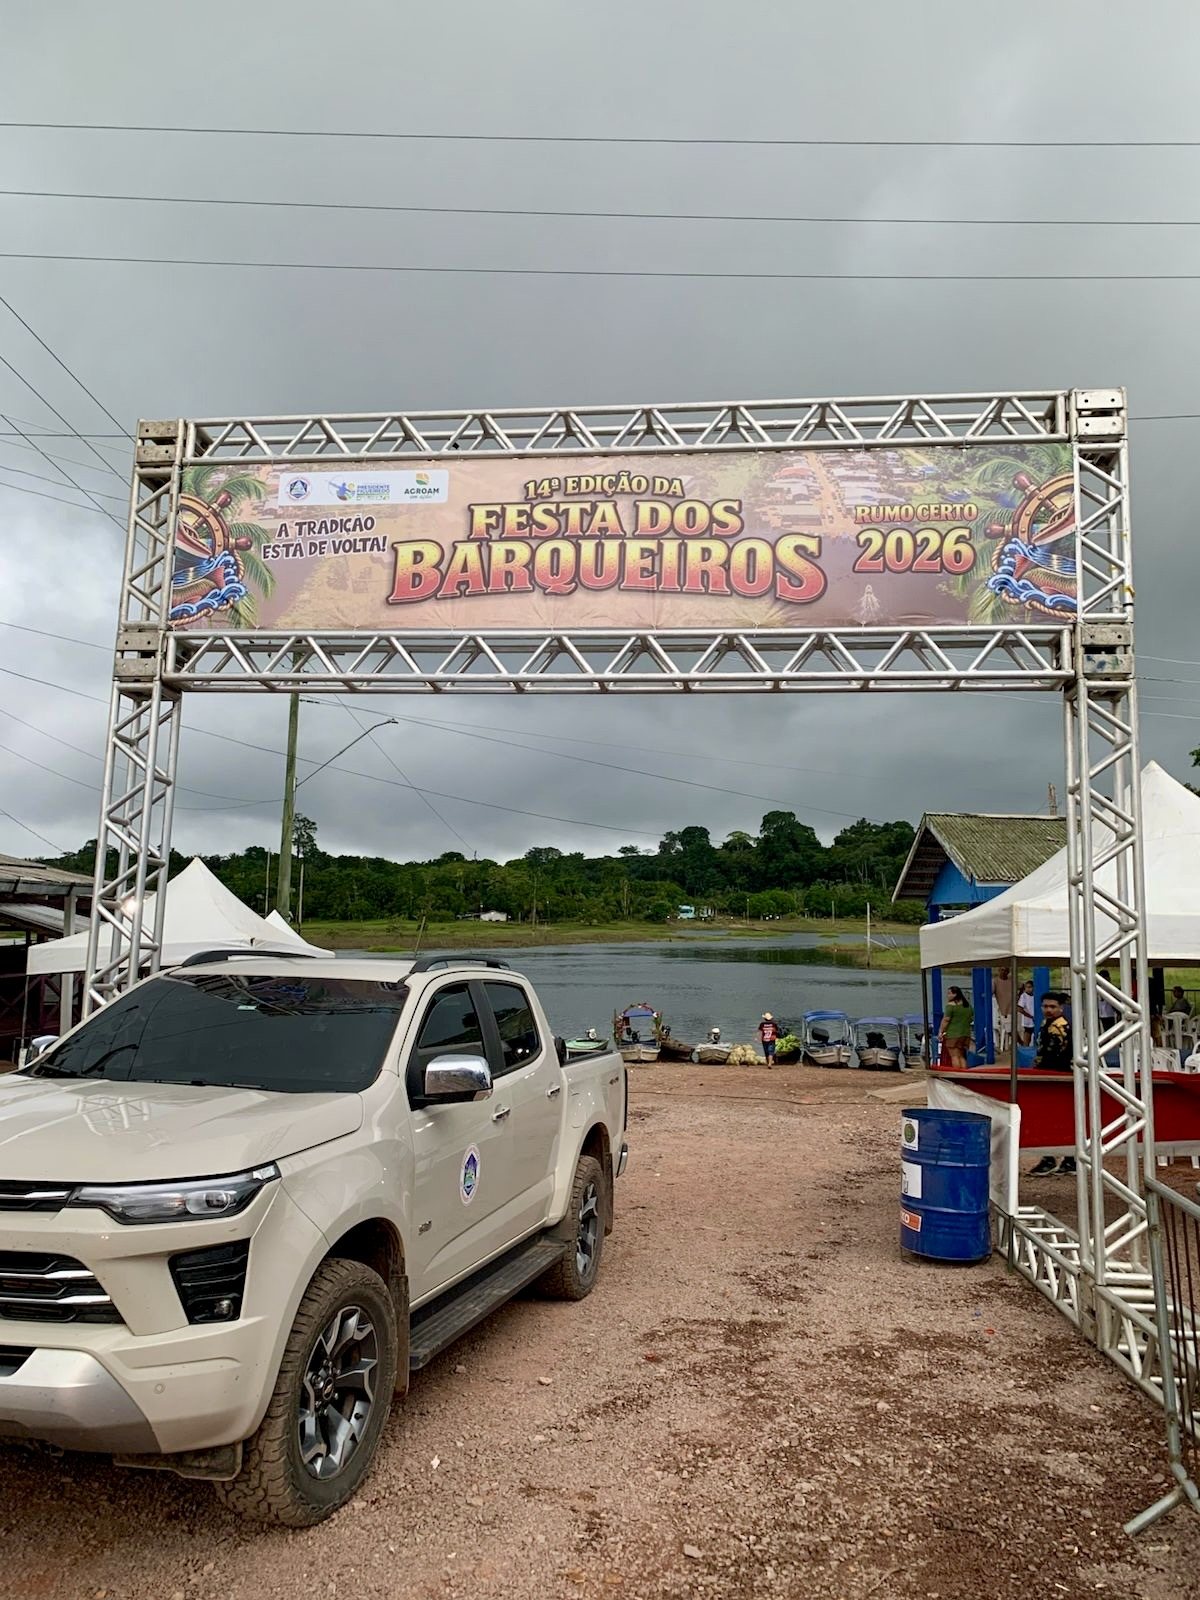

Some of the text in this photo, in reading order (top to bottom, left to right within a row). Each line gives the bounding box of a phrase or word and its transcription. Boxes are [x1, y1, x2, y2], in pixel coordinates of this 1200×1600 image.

[525, 471, 685, 500] 14ª EDIÇÃO DA
[277, 515, 375, 537] A TRADIÇÃO
[468, 500, 744, 540] FESTA DOS
[854, 503, 978, 524] RUMO CERTO
[263, 535, 387, 559] ESTÁ DE VOLTA!
[853, 527, 976, 574] 2026
[387, 532, 828, 605] BARQUEIROS
